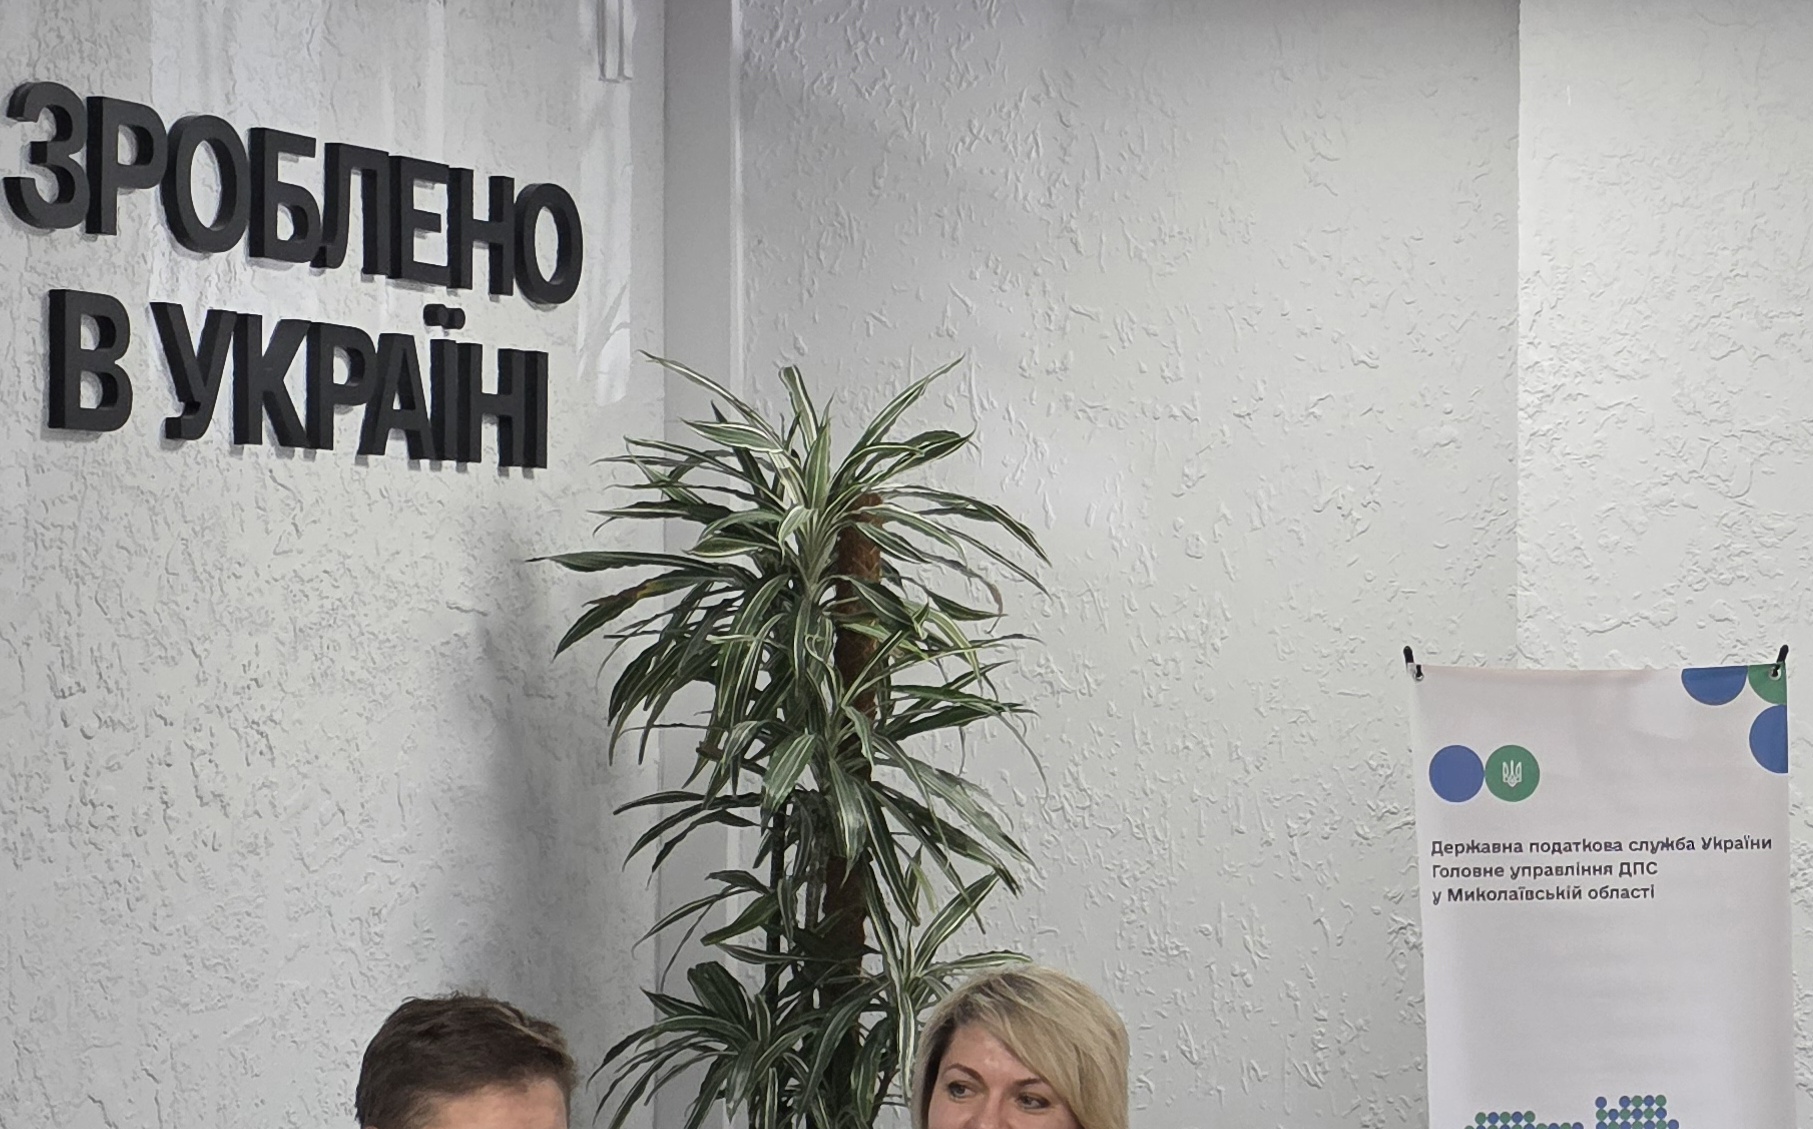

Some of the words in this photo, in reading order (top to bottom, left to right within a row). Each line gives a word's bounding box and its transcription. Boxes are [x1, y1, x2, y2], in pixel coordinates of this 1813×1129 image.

[4, 82, 583, 304] ЗРОБЛЕНО
[48, 289, 133, 432] В
[150, 302, 548, 469] УКРАЇНІ
[1431, 840, 1523, 857] Державна
[1529, 839, 1623, 854] податкова
[1629, 837, 1695, 854] служба
[1701, 835, 1772, 853] України
[1432, 865, 1504, 878] Головне
[1510, 862, 1612, 880] управління
[1619, 861, 1658, 877] ДПС
[1432, 890, 1442, 905] у
[1447, 885, 1582, 901] Миколаївській
[1588, 884, 1655, 899] області
